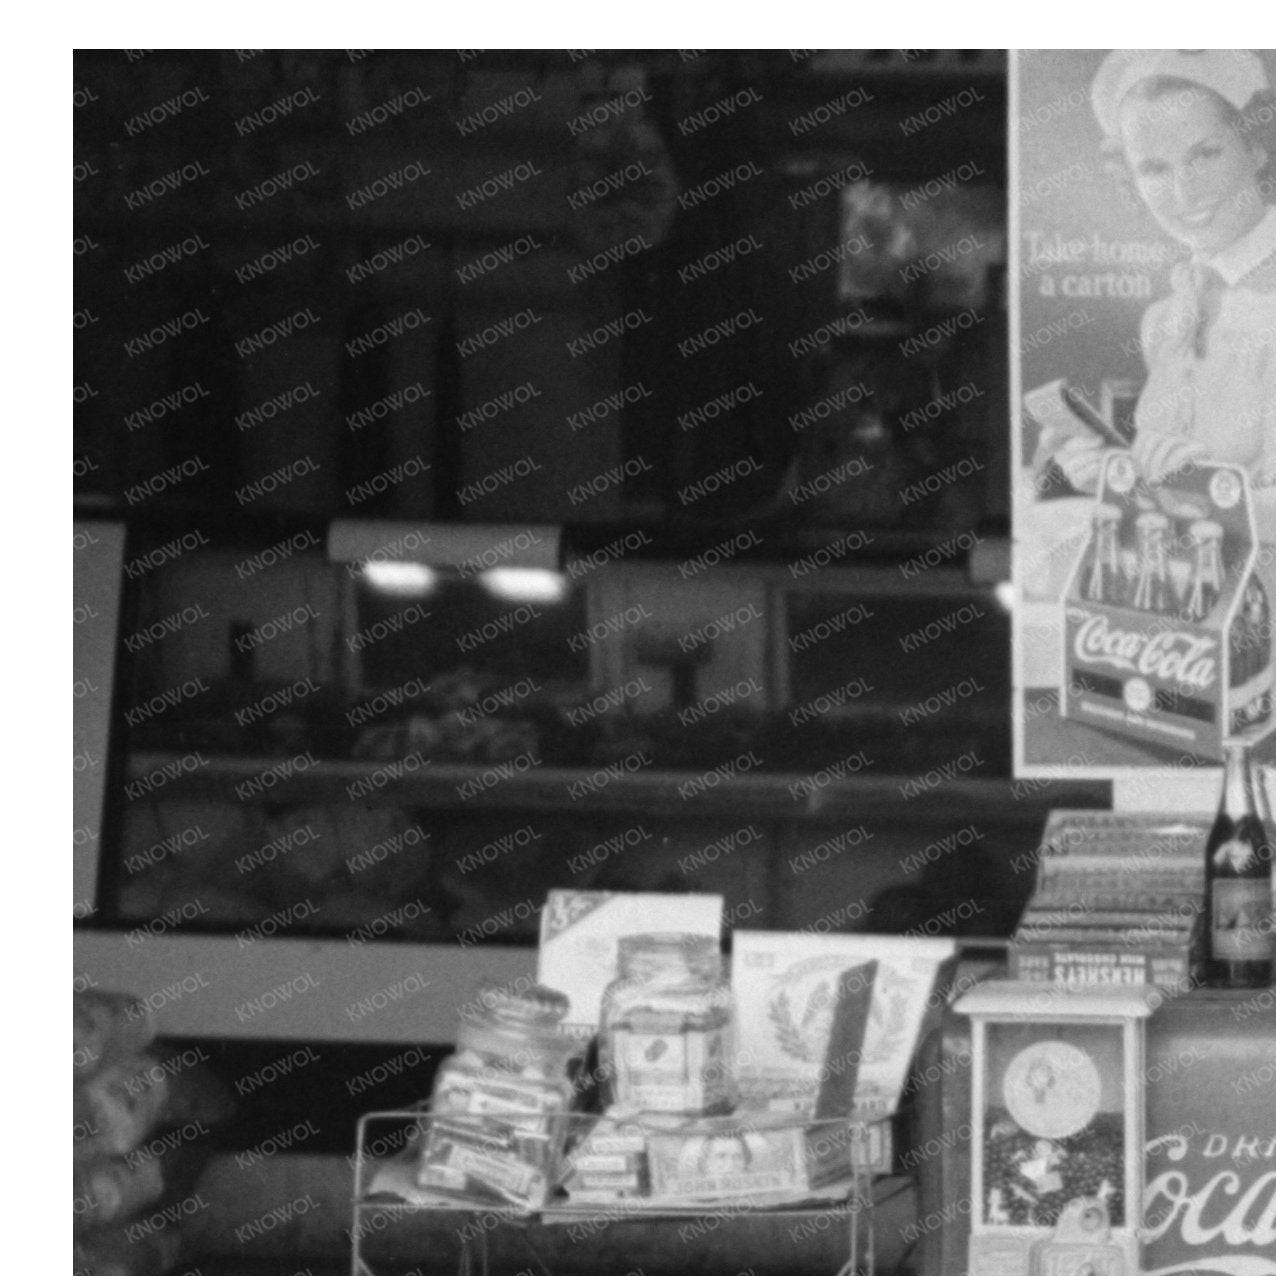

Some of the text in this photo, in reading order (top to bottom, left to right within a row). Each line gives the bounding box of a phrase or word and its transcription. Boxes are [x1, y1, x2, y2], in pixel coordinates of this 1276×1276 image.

[1023, 230, 1165, 263] Take home
[1039, 272, 1152, 298] a carton
[1075, 614, 1217, 688] Coca-Cola
